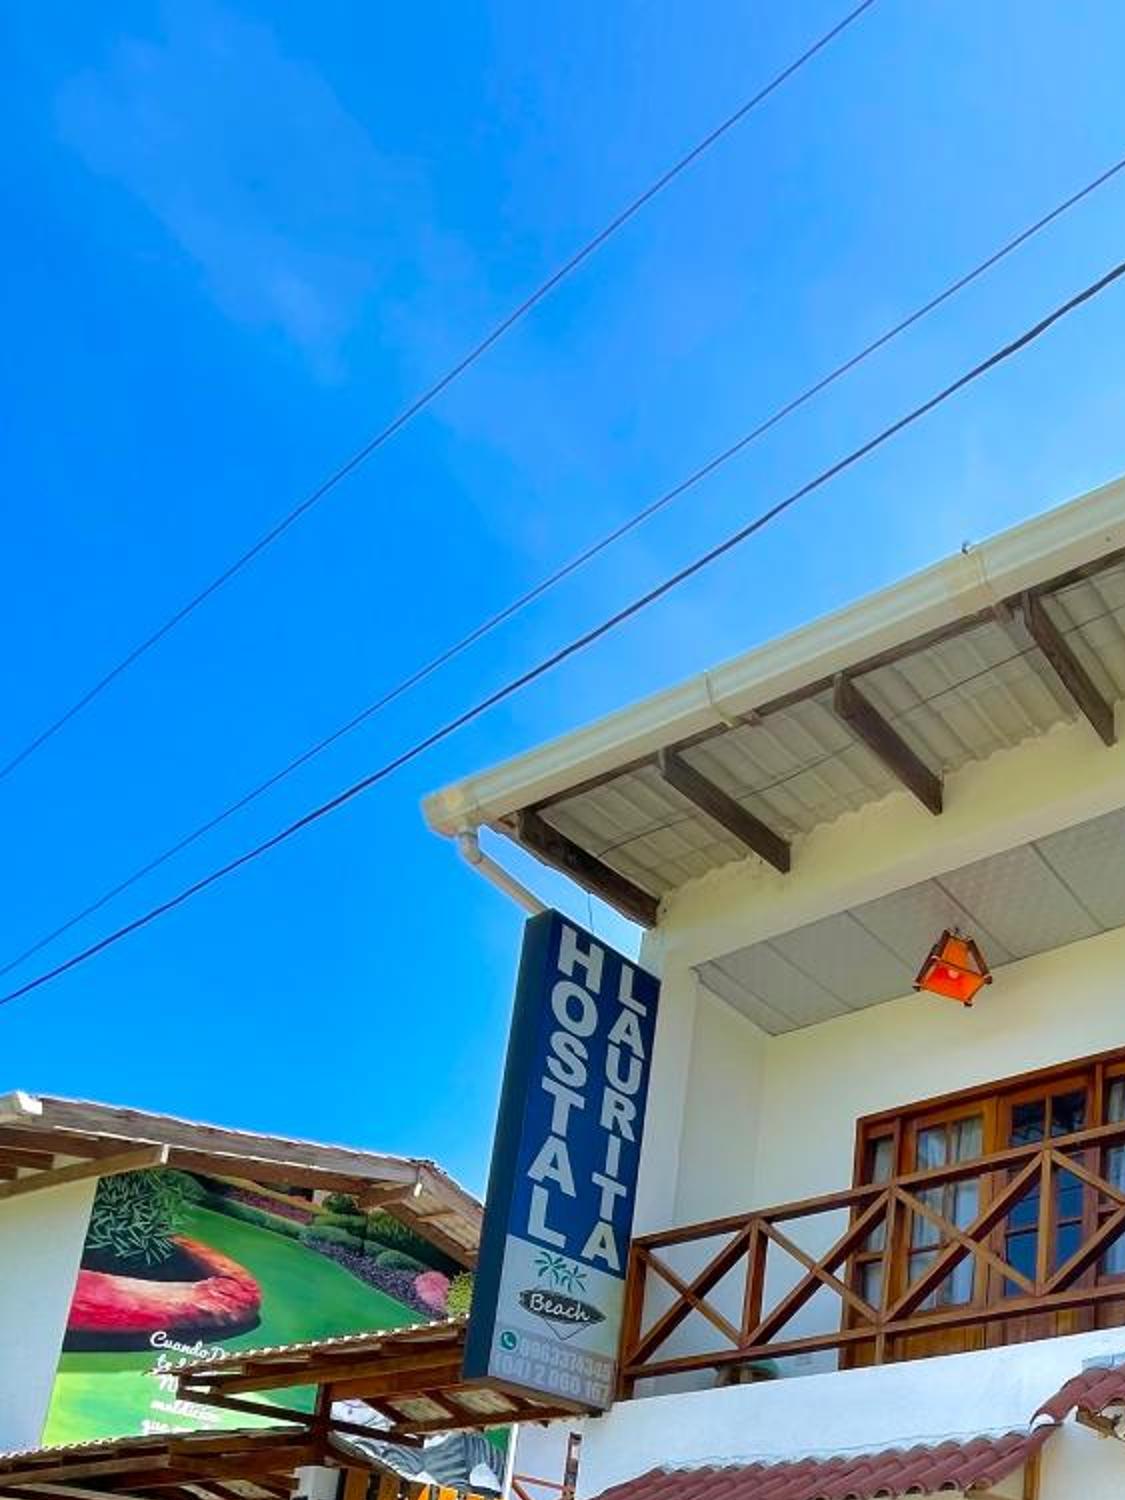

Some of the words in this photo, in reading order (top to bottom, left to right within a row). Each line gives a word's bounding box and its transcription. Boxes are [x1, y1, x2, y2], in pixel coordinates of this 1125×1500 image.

[526, 923, 604, 1249] HOSTAL
[579, 964, 648, 1273] LAURITA
[150, 1330, 209, 1358] Cuando
[529, 1293, 591, 1321] Beach
